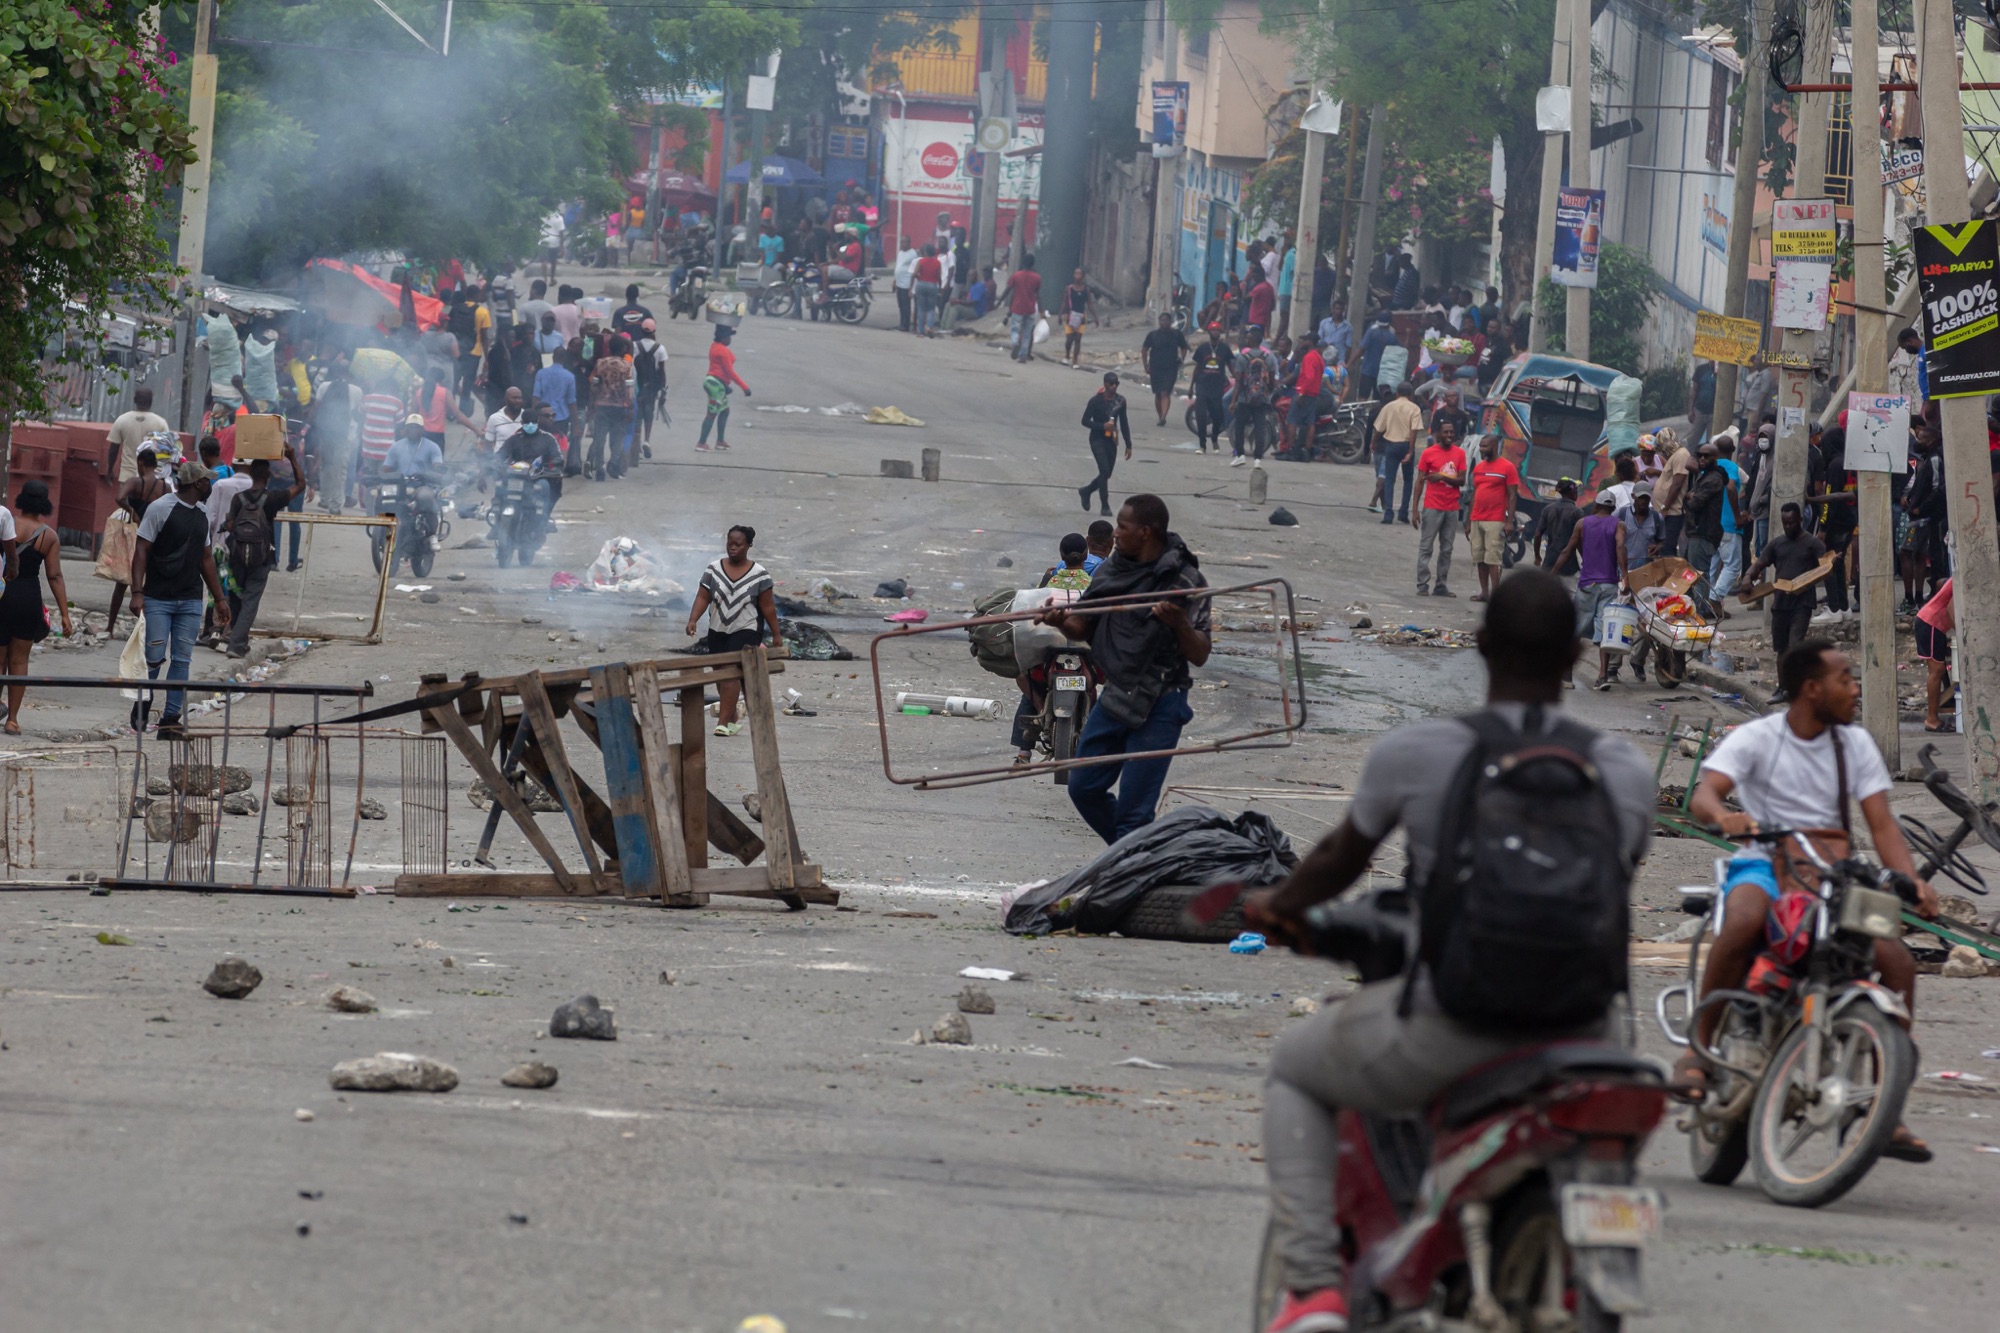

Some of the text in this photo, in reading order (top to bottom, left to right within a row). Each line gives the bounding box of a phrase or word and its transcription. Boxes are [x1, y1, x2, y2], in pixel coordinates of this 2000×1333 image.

[1776, 203, 1833, 219] UNEP
[1775, 244, 1794, 252] TELS:
[1927, 279, 1998, 324] 100%
[1932, 301, 1999, 335] CASHBACK
[1949, 329, 1971, 342] PREMYE
[1940, 371, 2000, 382] LISAPARYAJ.COM
[1792, 381, 1804, 408] 5
